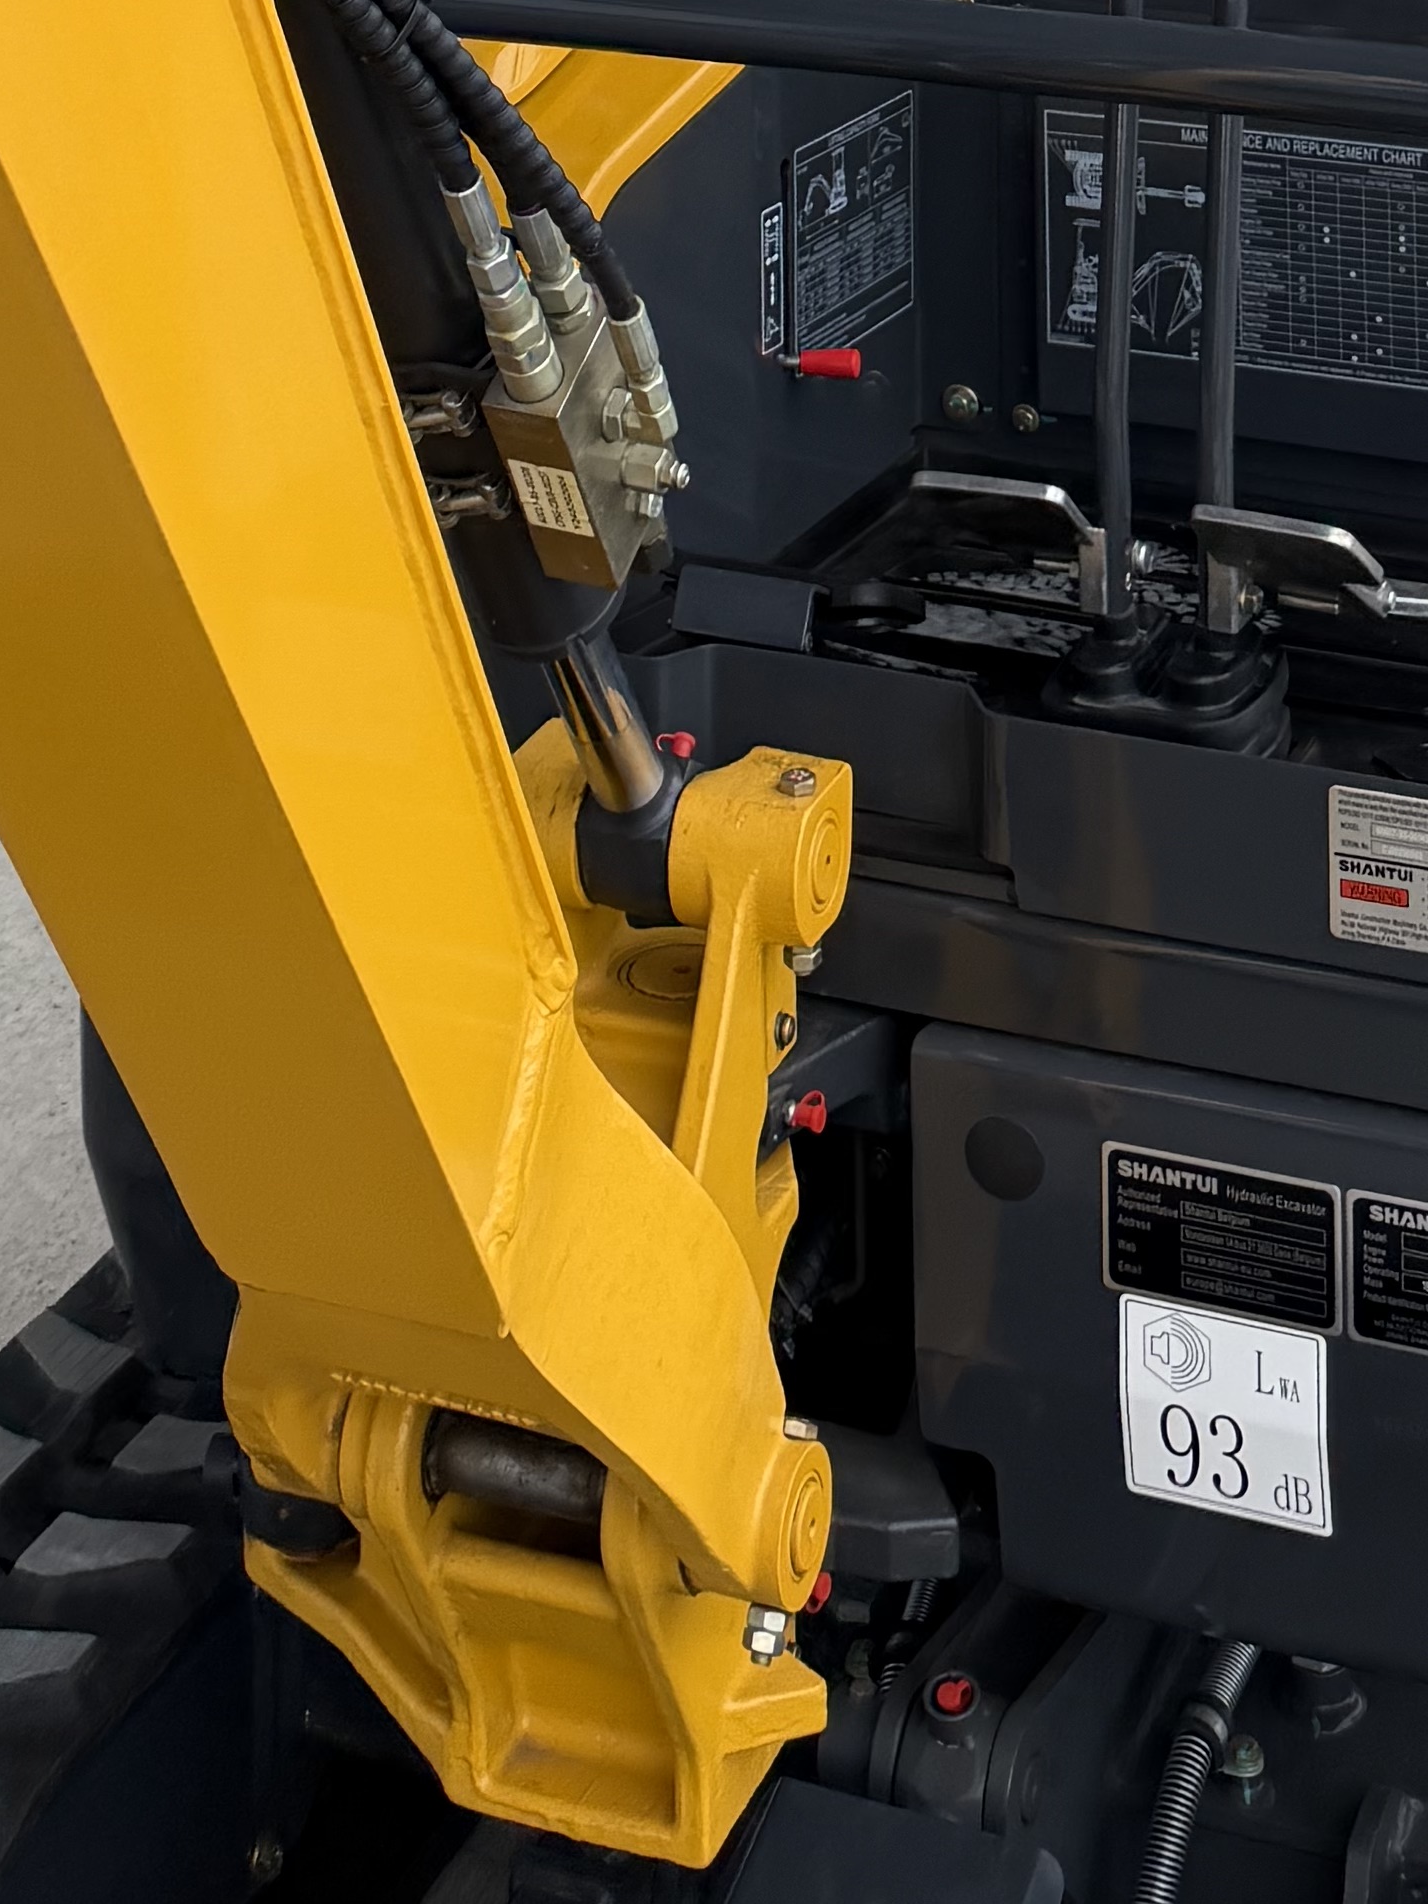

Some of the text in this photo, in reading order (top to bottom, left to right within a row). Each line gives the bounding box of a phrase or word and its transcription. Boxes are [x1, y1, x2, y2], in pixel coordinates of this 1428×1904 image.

[1265, 136, 1291, 153] AND
[1292, 139, 1380, 162] REPLACEMENT
[1381, 148, 1423, 168] CHART
[1338, 859, 1414, 883] SHANTUI
[1117, 1158, 1327, 1217] SHANTUI Hydraulic Excavator
[1159, 1403, 1250, 1500] 93
[1273, 1473, 1314, 1517] dB
